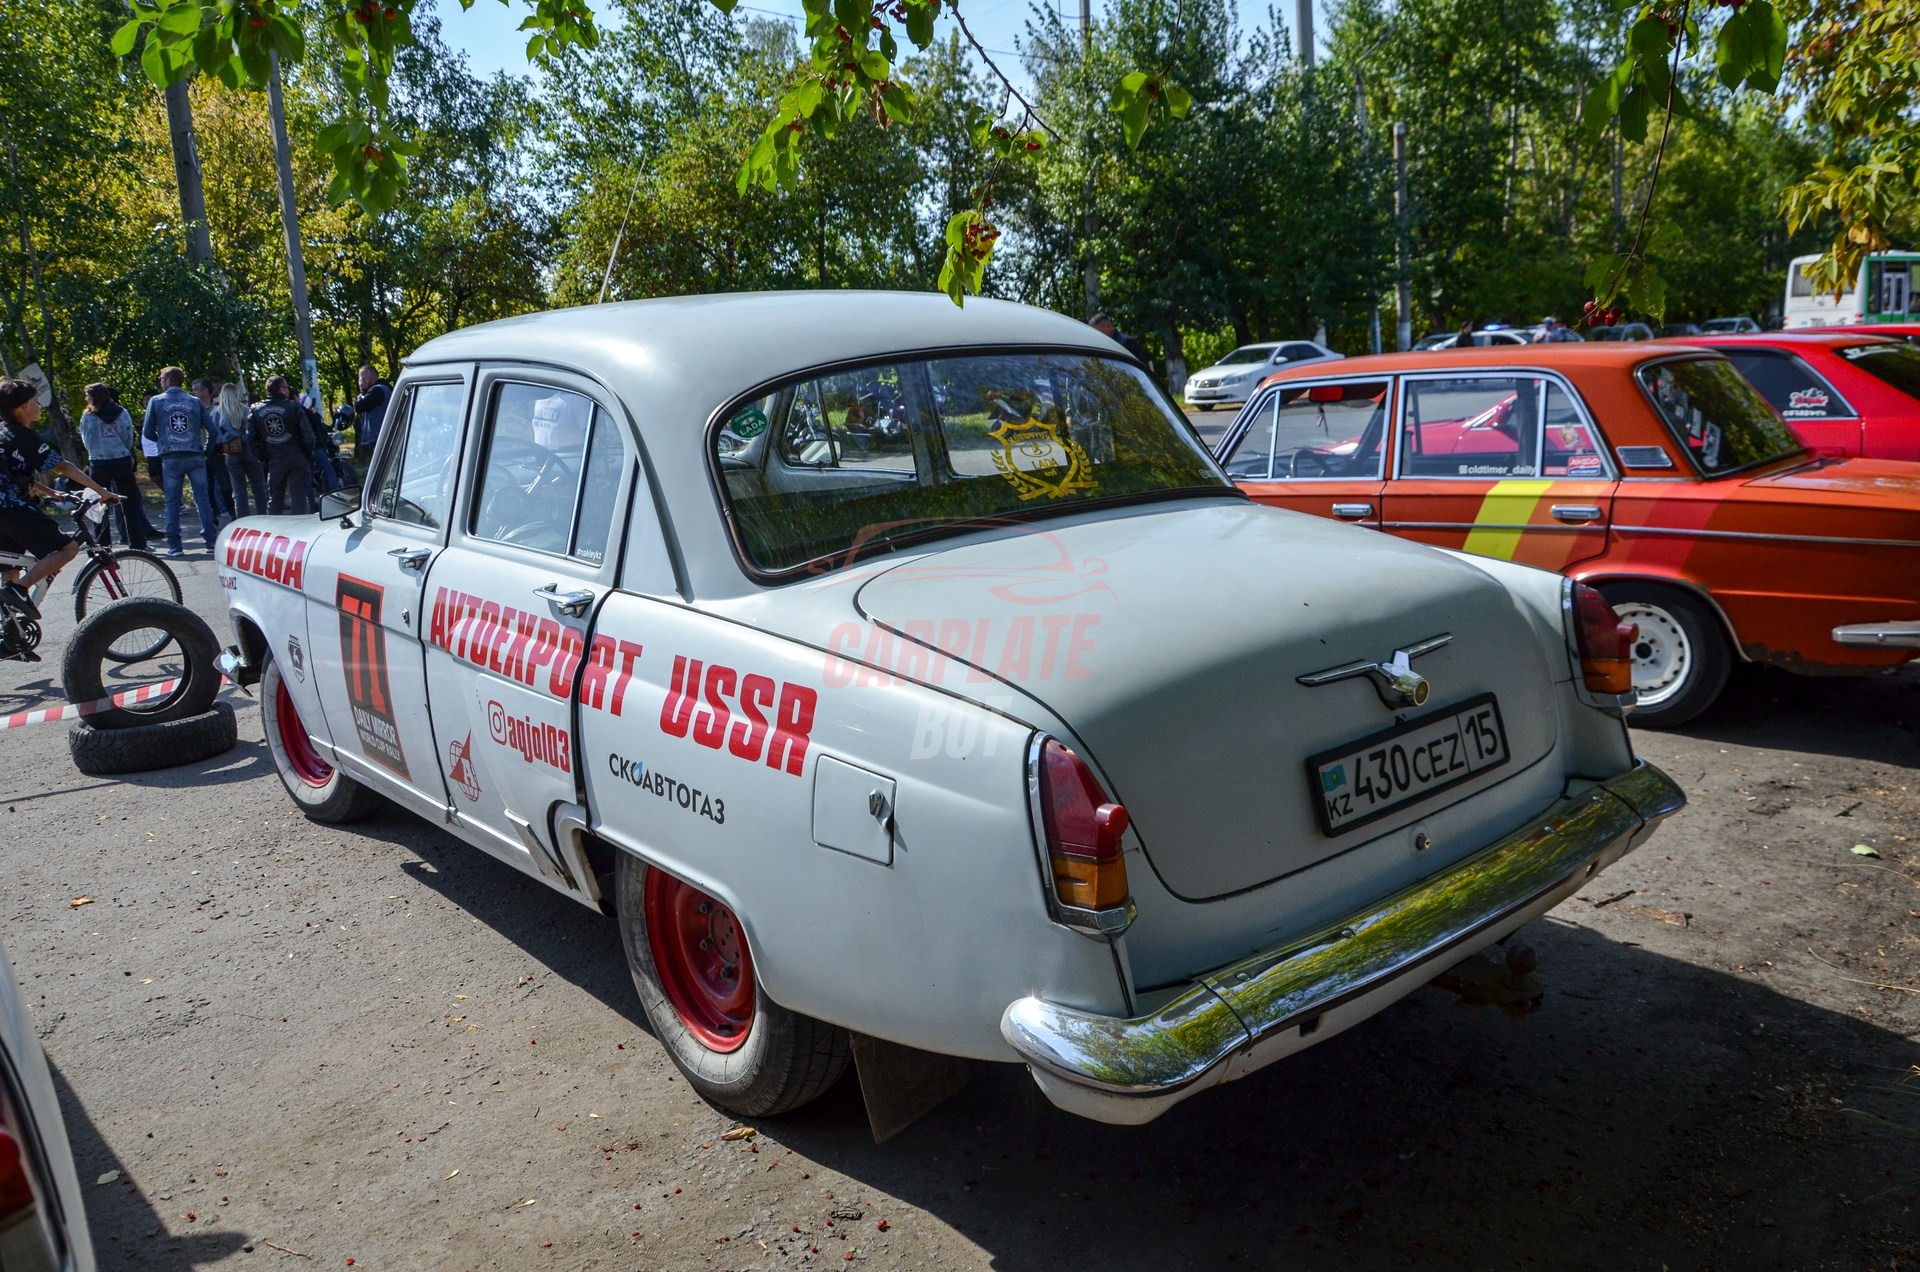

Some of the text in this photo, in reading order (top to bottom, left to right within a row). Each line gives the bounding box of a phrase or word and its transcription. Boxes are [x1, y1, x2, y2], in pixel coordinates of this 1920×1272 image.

[740, 420, 765, 436] LADA
[226, 527, 307, 590] VOLGA
[430, 586, 818, 778] AVTOEXPORT USSR
[353, 705, 398, 747] DAILY MIRROR
[1328, 793, 1353, 820] KZ
[1465, 710, 1498, 760] 15
